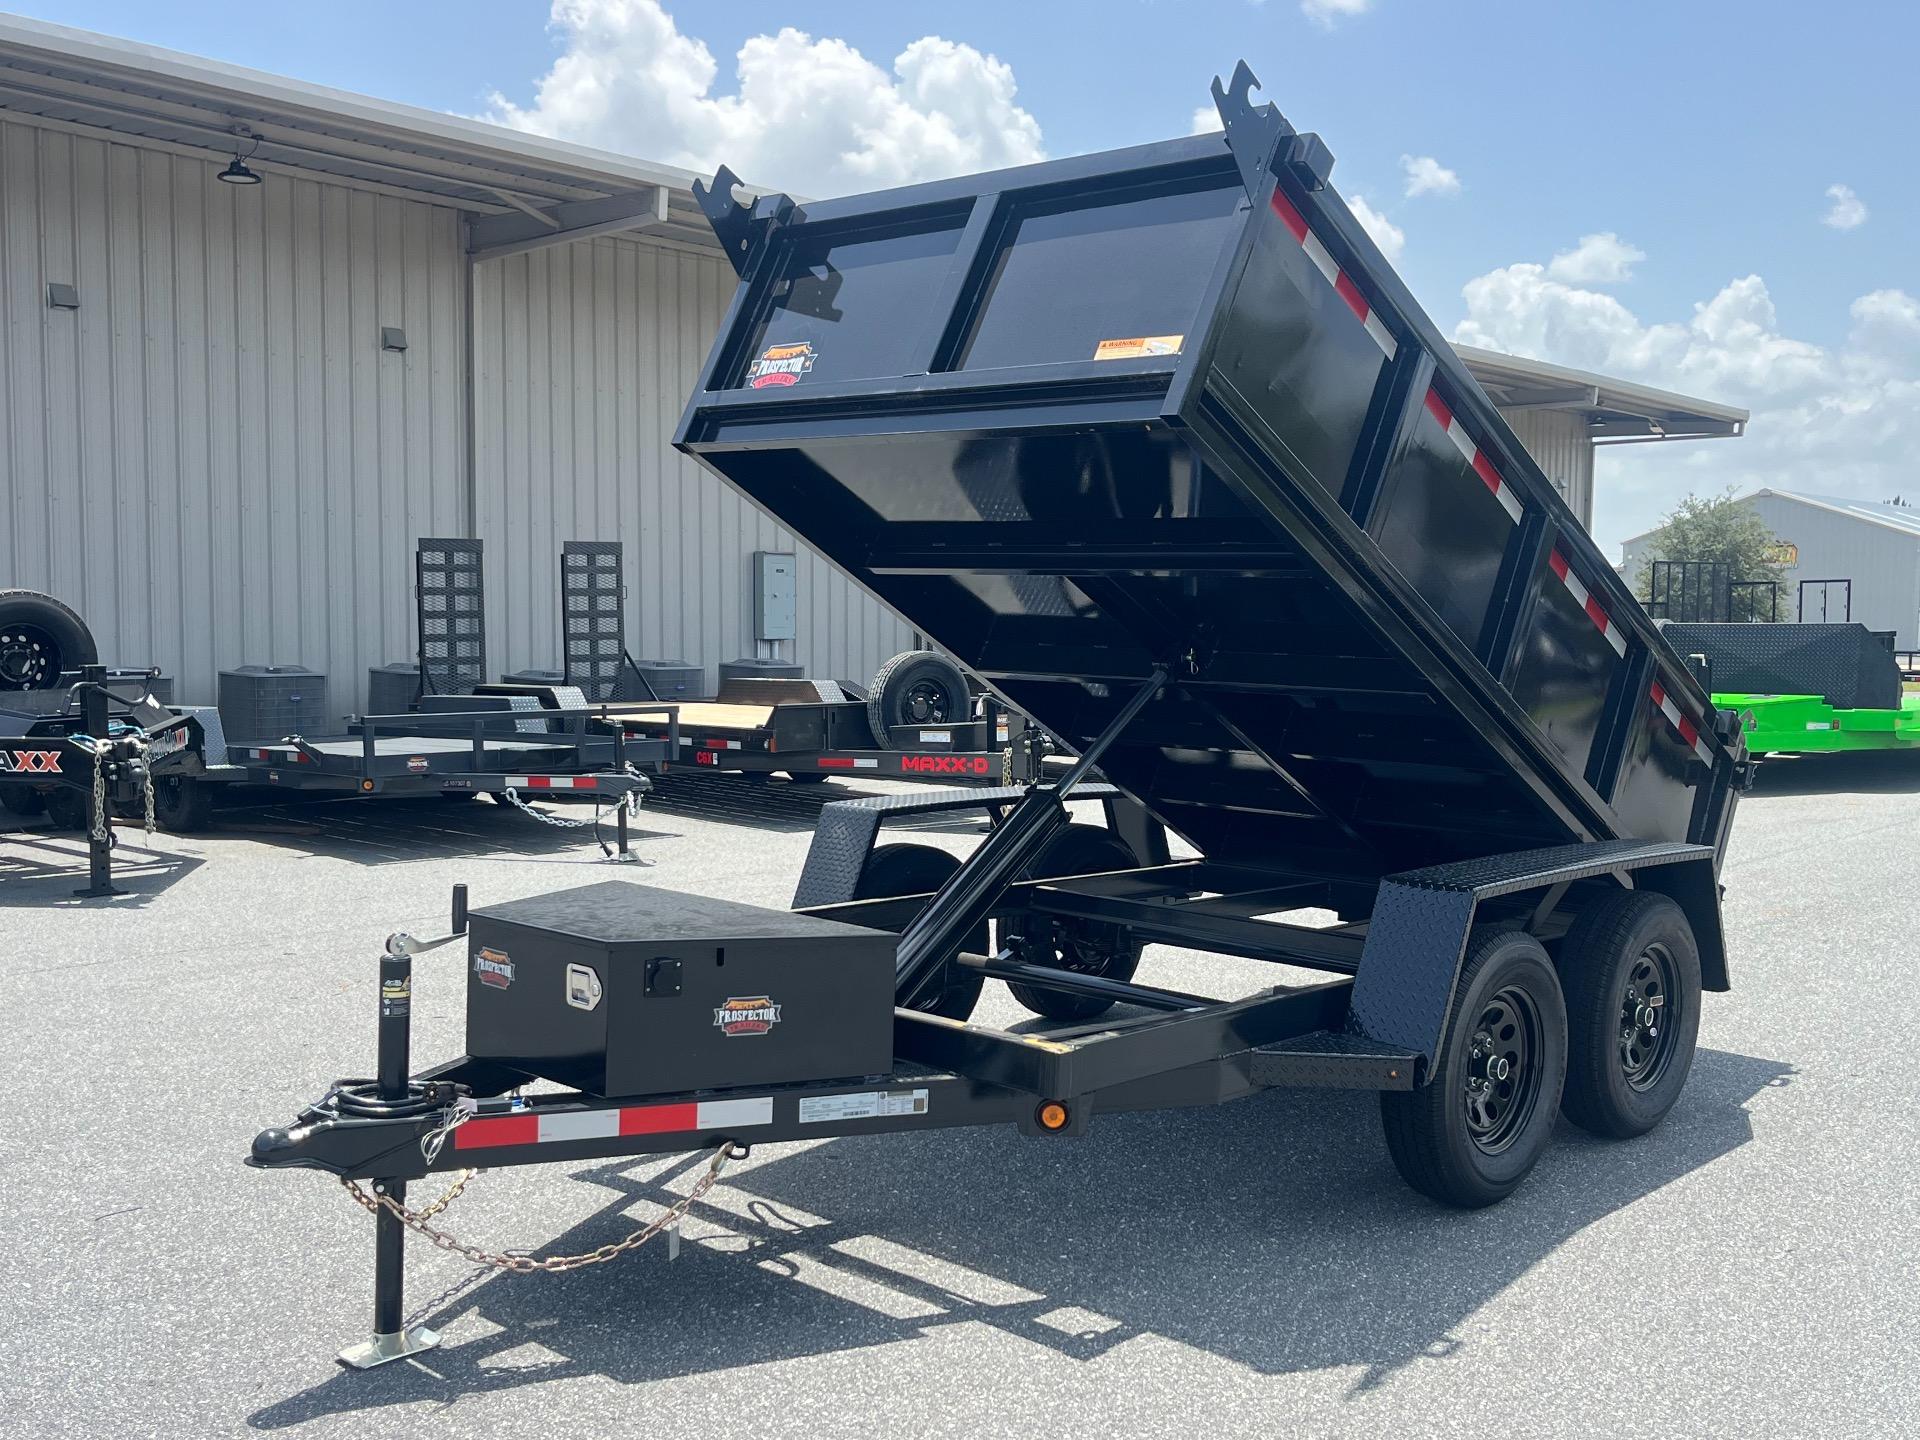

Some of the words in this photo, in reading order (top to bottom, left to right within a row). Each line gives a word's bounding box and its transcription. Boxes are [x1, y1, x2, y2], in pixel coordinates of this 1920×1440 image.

[901, 755, 989, 773] MAXX-D
[477, 957, 513, 978] PROSPECTOR
[718, 1007, 776, 1023] PROSPECTOR
